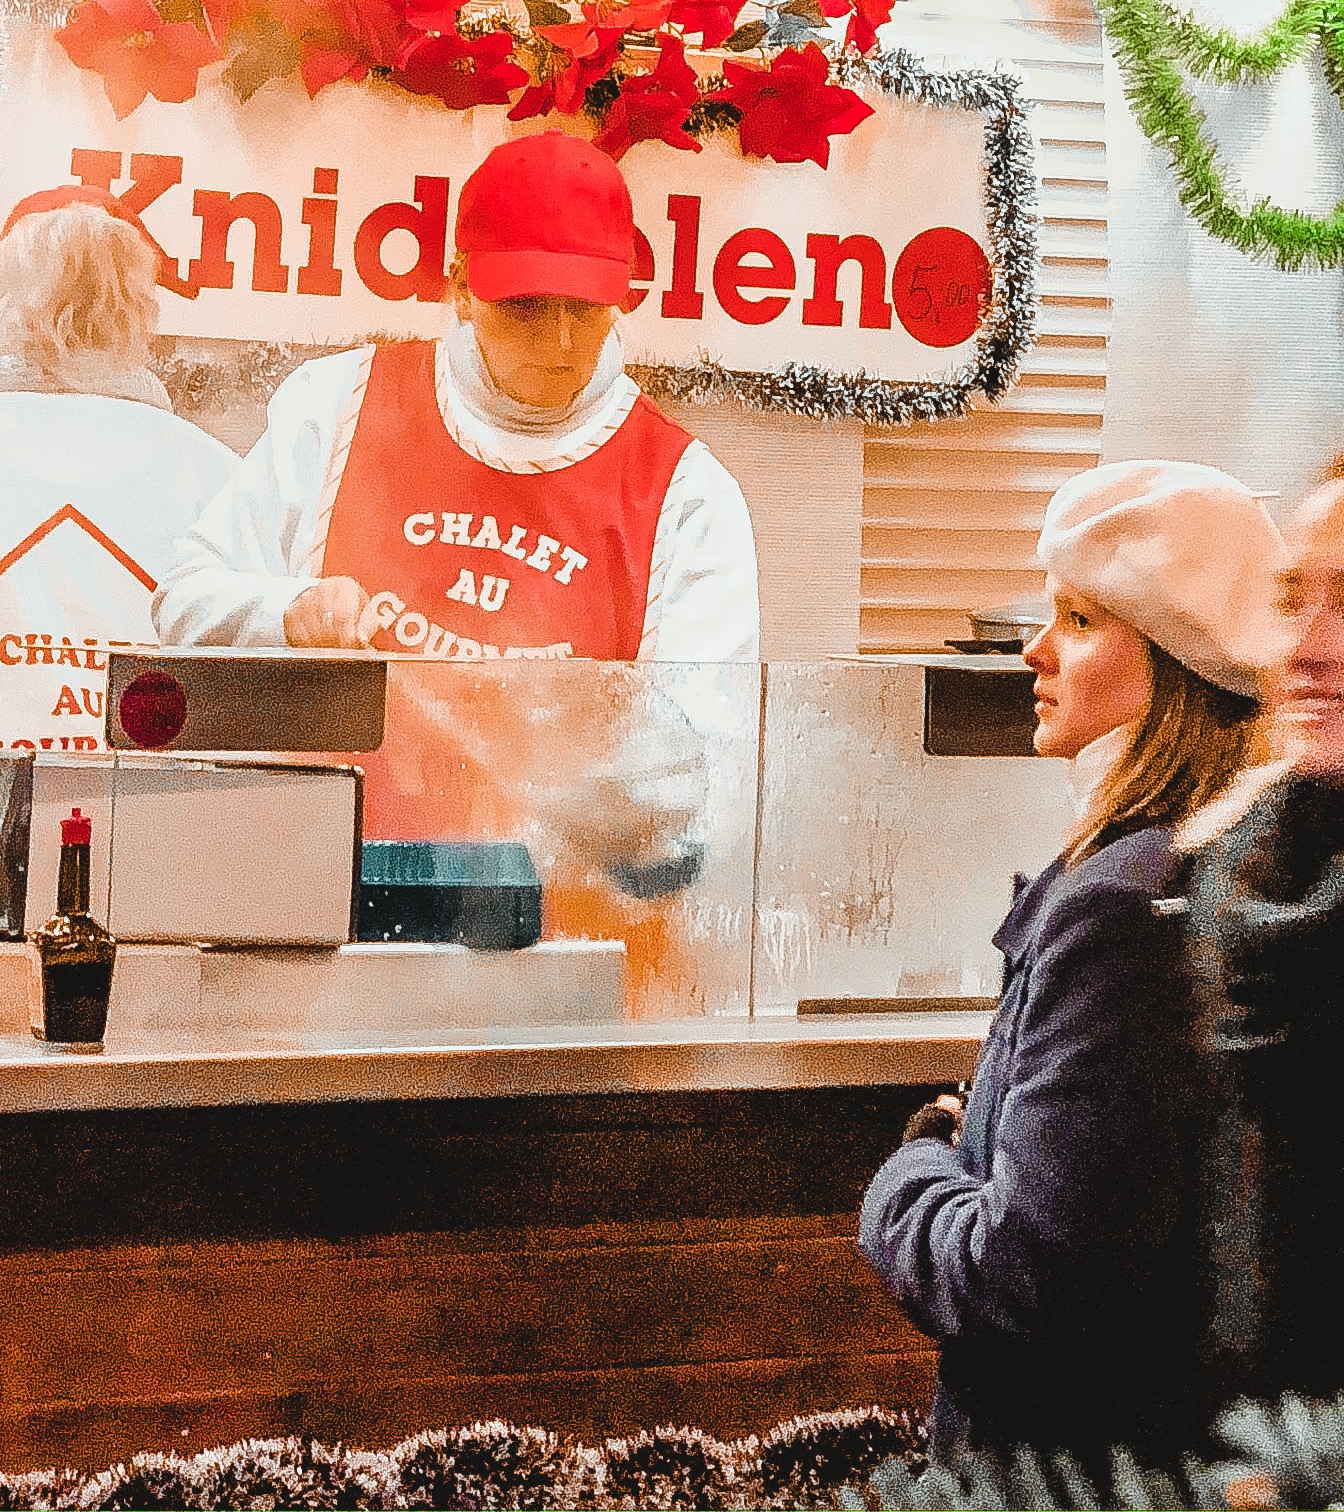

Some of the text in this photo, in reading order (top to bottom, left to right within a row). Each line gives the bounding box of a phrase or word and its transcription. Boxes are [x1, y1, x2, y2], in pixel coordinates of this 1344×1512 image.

[403, 511, 589, 585] CHALET
[445, 568, 511, 612] AU
[51, 685, 104, 718] AU
